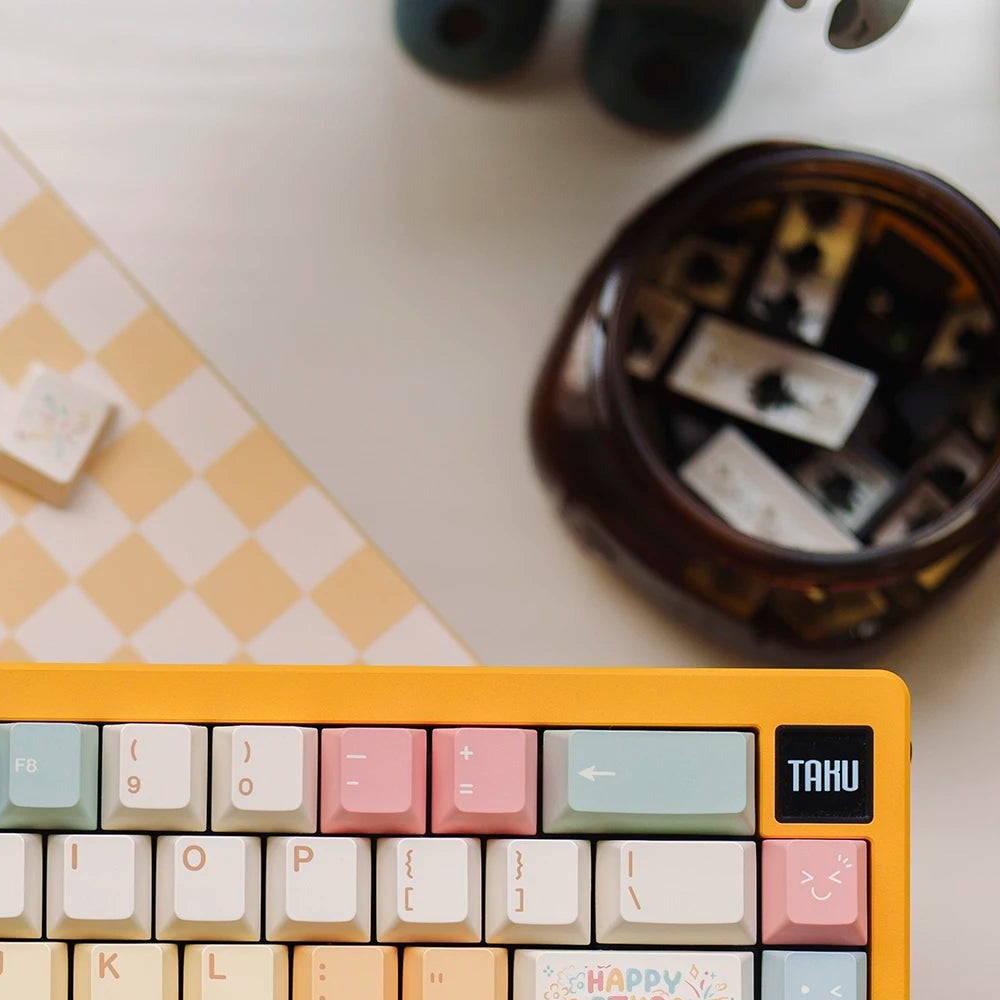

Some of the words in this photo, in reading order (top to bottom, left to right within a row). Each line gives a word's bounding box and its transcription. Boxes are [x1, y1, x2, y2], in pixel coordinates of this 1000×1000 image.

[130, 738, 138, 762] (
[244, 741, 251, 763] )
[459, 745, 474, 760] +
[15, 758, 38, 773] F8
[787, 759, 859, 792] TAKU
[127, 776, 141, 794] 9
[71, 843, 78, 870] I
[182, 845, 206, 871] O
[293, 845, 314, 872] P
[405, 849, 414, 879] {
[515, 850, 523, 880] }
[405, 887, 414, 911] [
[515, 888, 524, 912] ]
[99, 952, 120, 979] K
[209, 953, 227, 979] L
[587, 967, 682, 994] HAPPY
